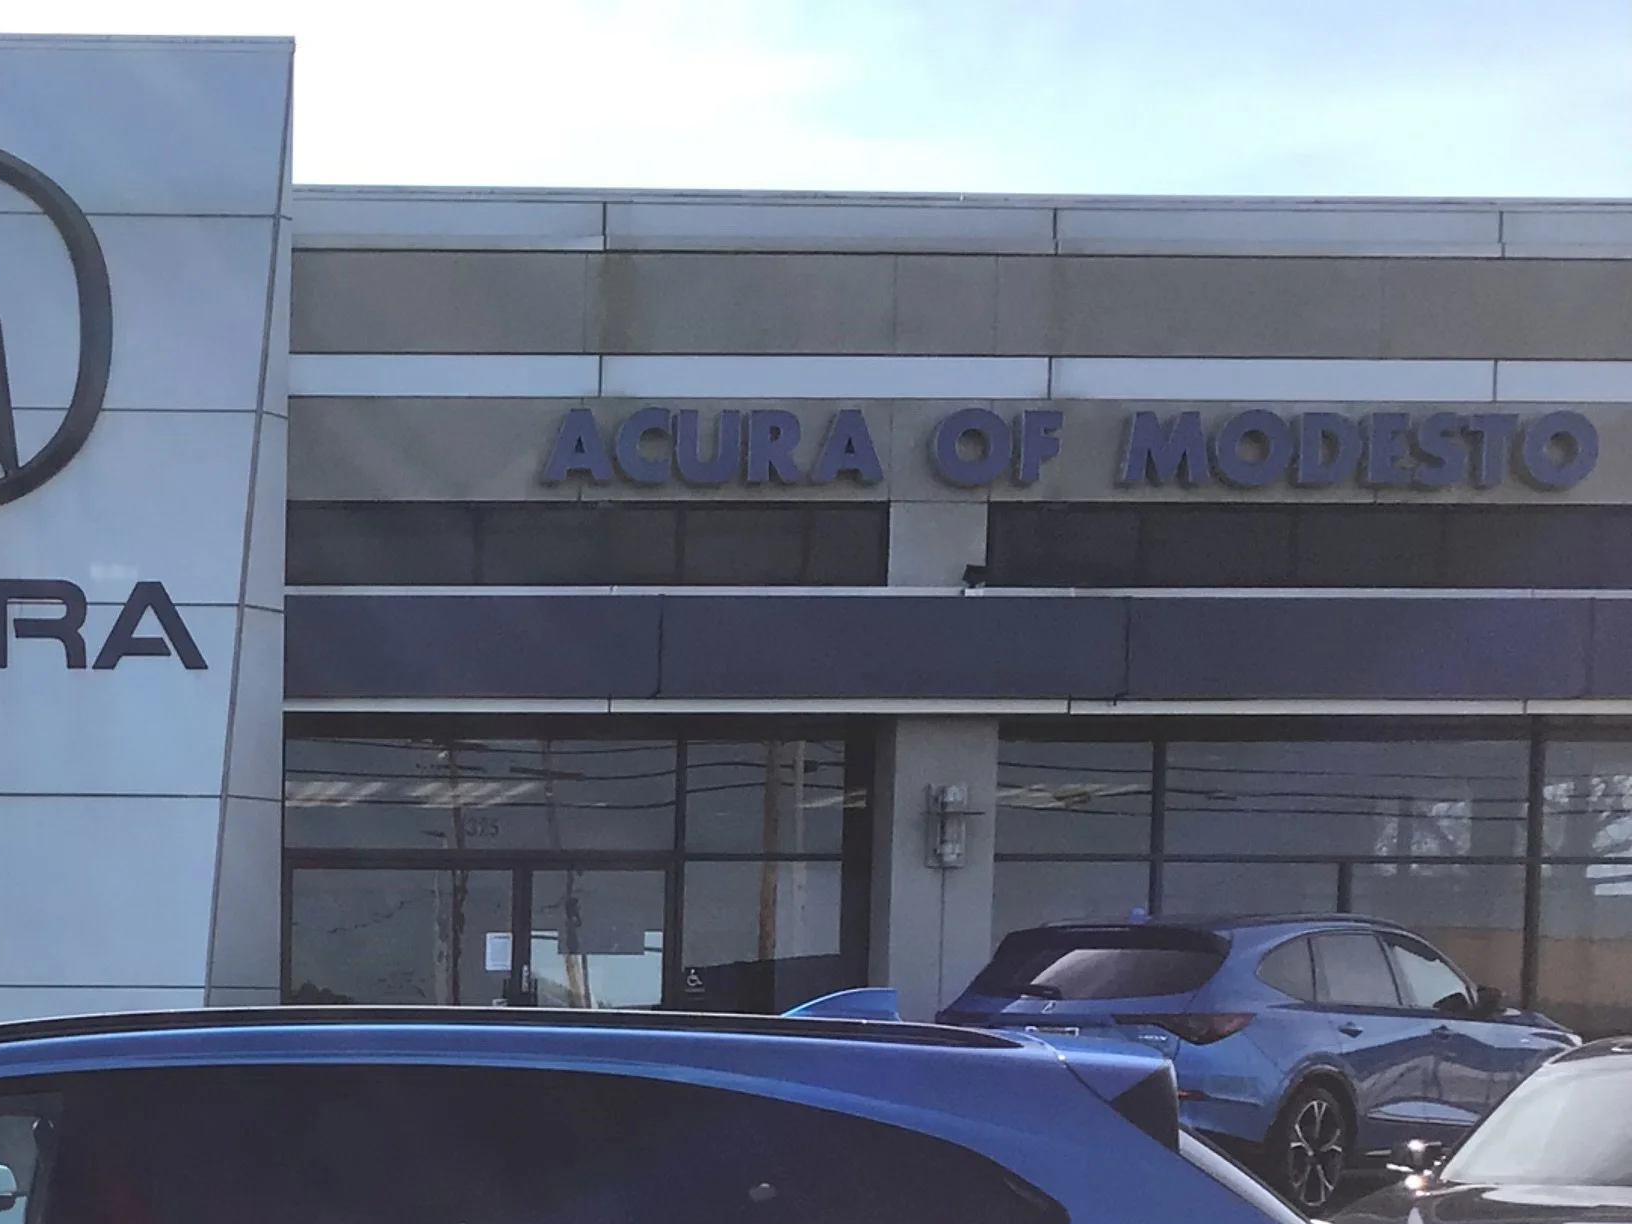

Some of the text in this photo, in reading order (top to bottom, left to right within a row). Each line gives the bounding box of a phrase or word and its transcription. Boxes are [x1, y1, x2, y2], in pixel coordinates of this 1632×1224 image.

[542, 407, 1599, 489] ACURA OF MODESTO
